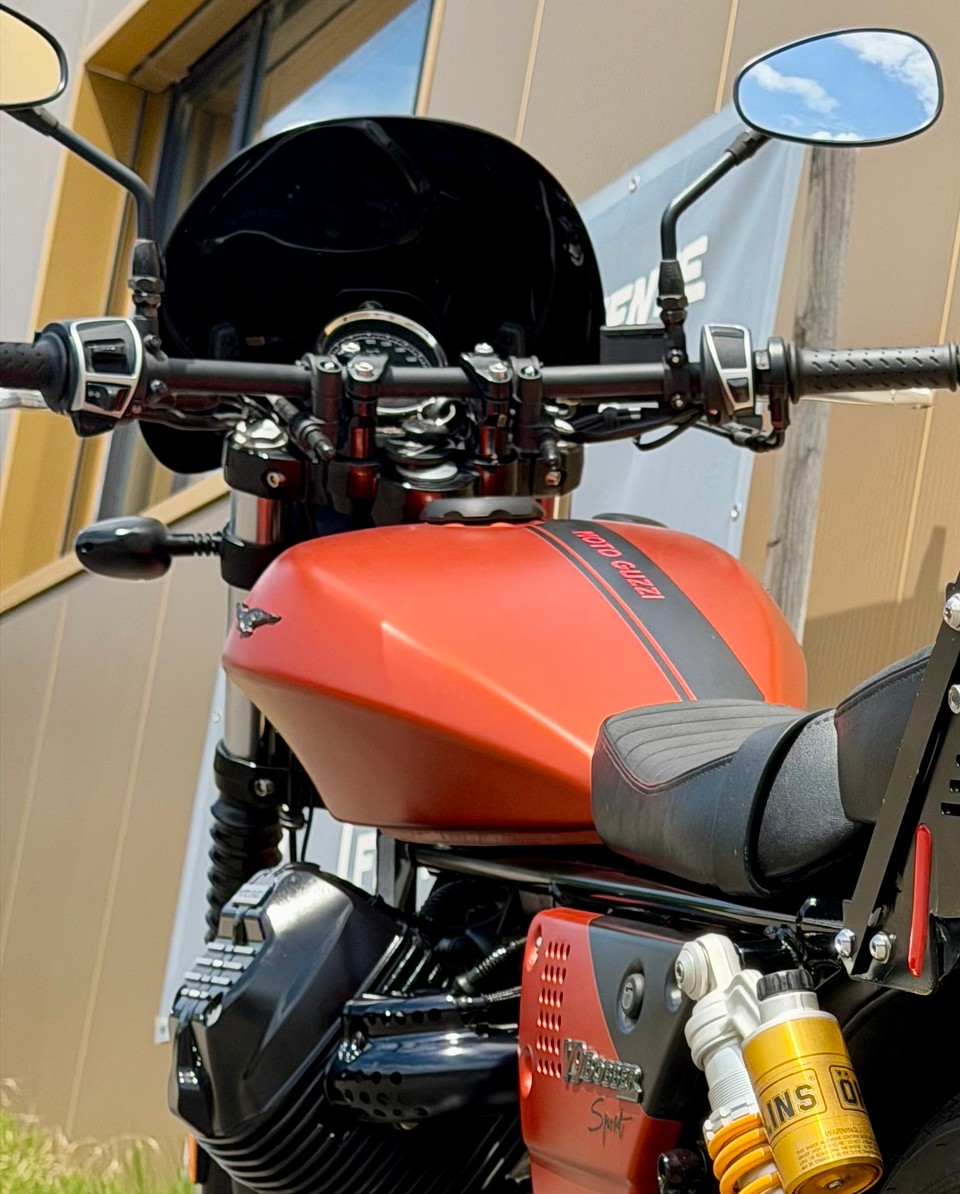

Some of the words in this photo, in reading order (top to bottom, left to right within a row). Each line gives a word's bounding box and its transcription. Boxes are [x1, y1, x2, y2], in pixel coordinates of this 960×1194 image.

[571, 530, 623, 558] MOTO
[611, 560, 666, 599] GUZZI
[588, 1097, 633, 1148] Sport
[765, 1083, 818, 1130] INS
